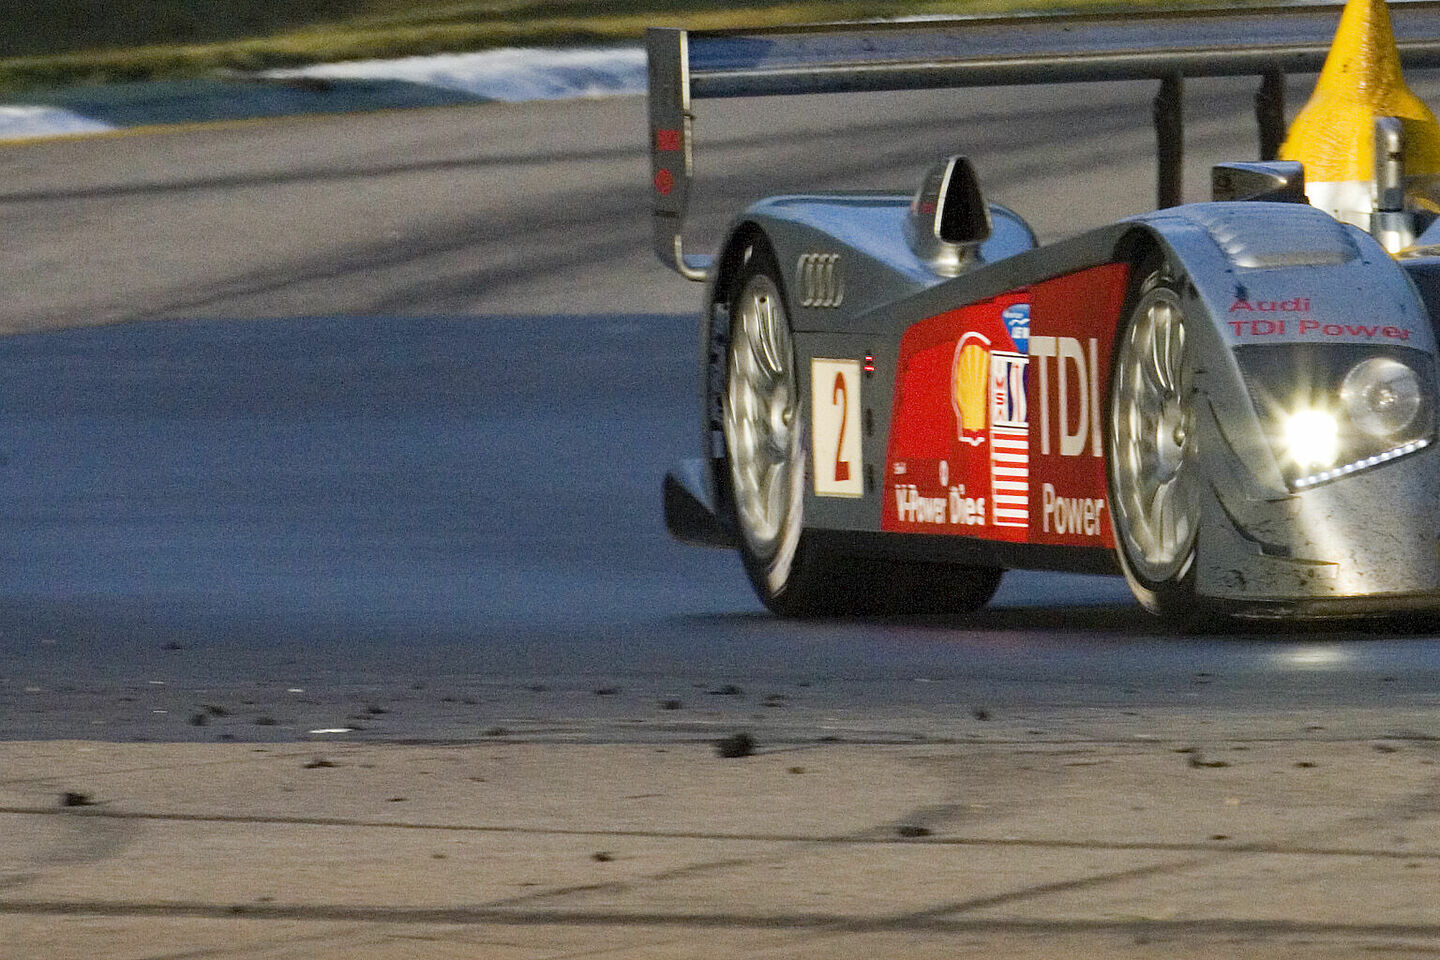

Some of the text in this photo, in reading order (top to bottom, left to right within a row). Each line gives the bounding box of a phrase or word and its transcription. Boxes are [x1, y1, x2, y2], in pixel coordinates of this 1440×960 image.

[1228, 297, 1311, 313] Audi
[1228, 319, 1414, 341] TDI Power
[1030, 336, 1103, 458] TDI
[832, 370, 850, 482] 2
[1043, 483, 1105, 536] Power
